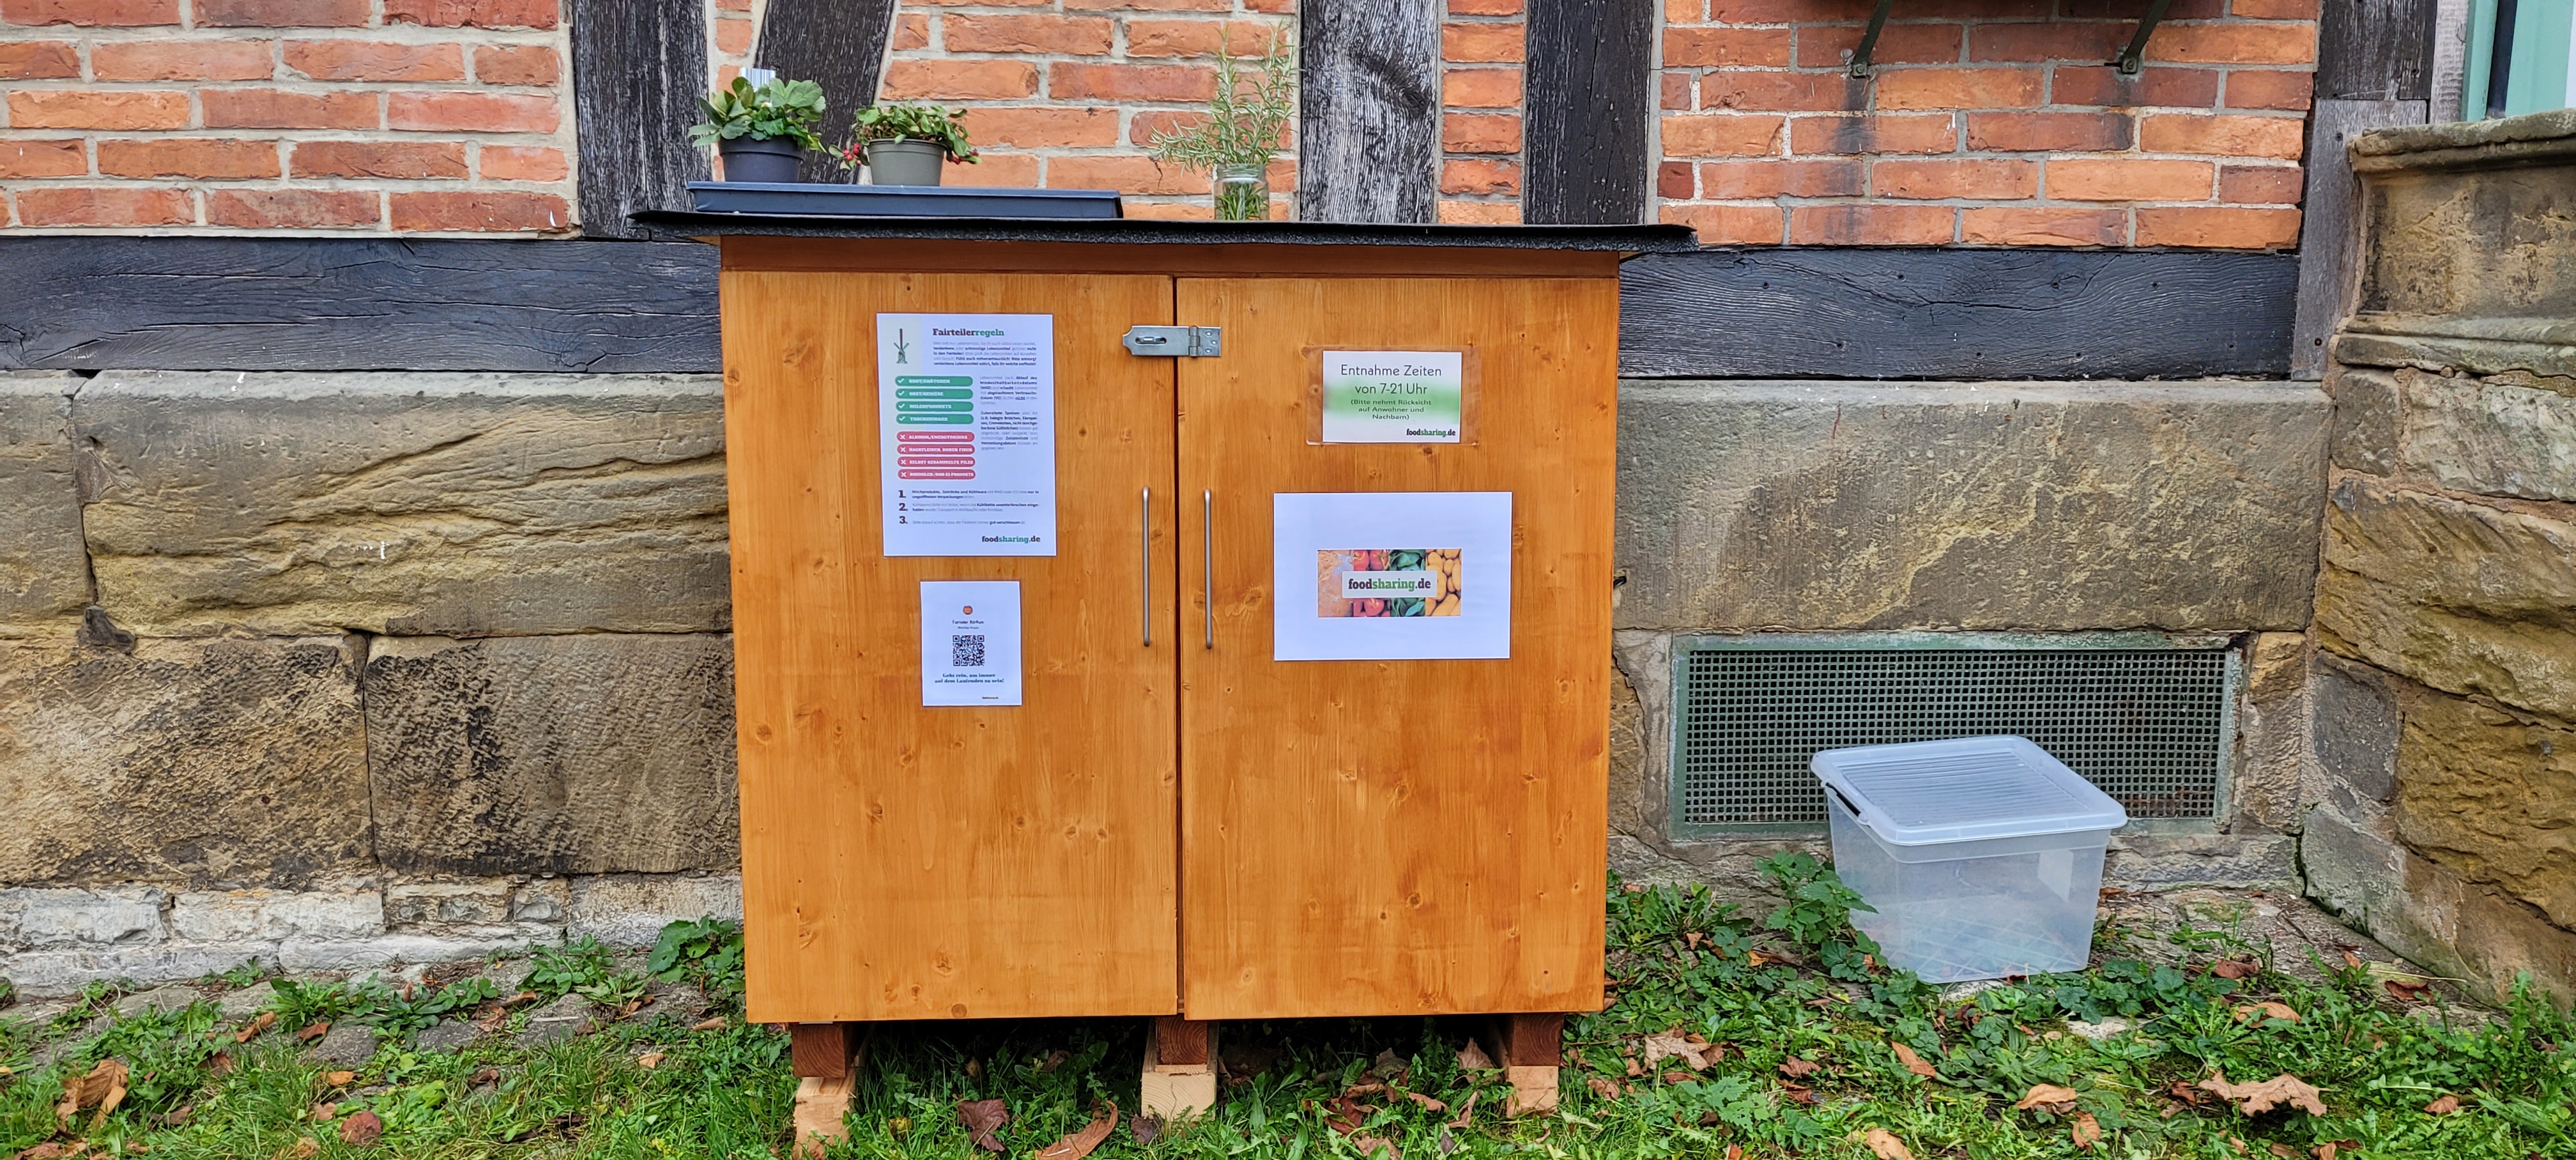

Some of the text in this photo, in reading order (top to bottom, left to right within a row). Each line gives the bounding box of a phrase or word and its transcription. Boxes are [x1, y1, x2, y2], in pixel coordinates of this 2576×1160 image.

[933, 328, 1004, 337] Fairteilerregeln
[1341, 364, 1442, 376] Entnahme Zeiten
[1355, 383, 1428, 394] von 7-21 Uhr
[1406, 429, 1455, 437] foodsharing.de
[1348, 578, 1431, 591] foodsharing.de
